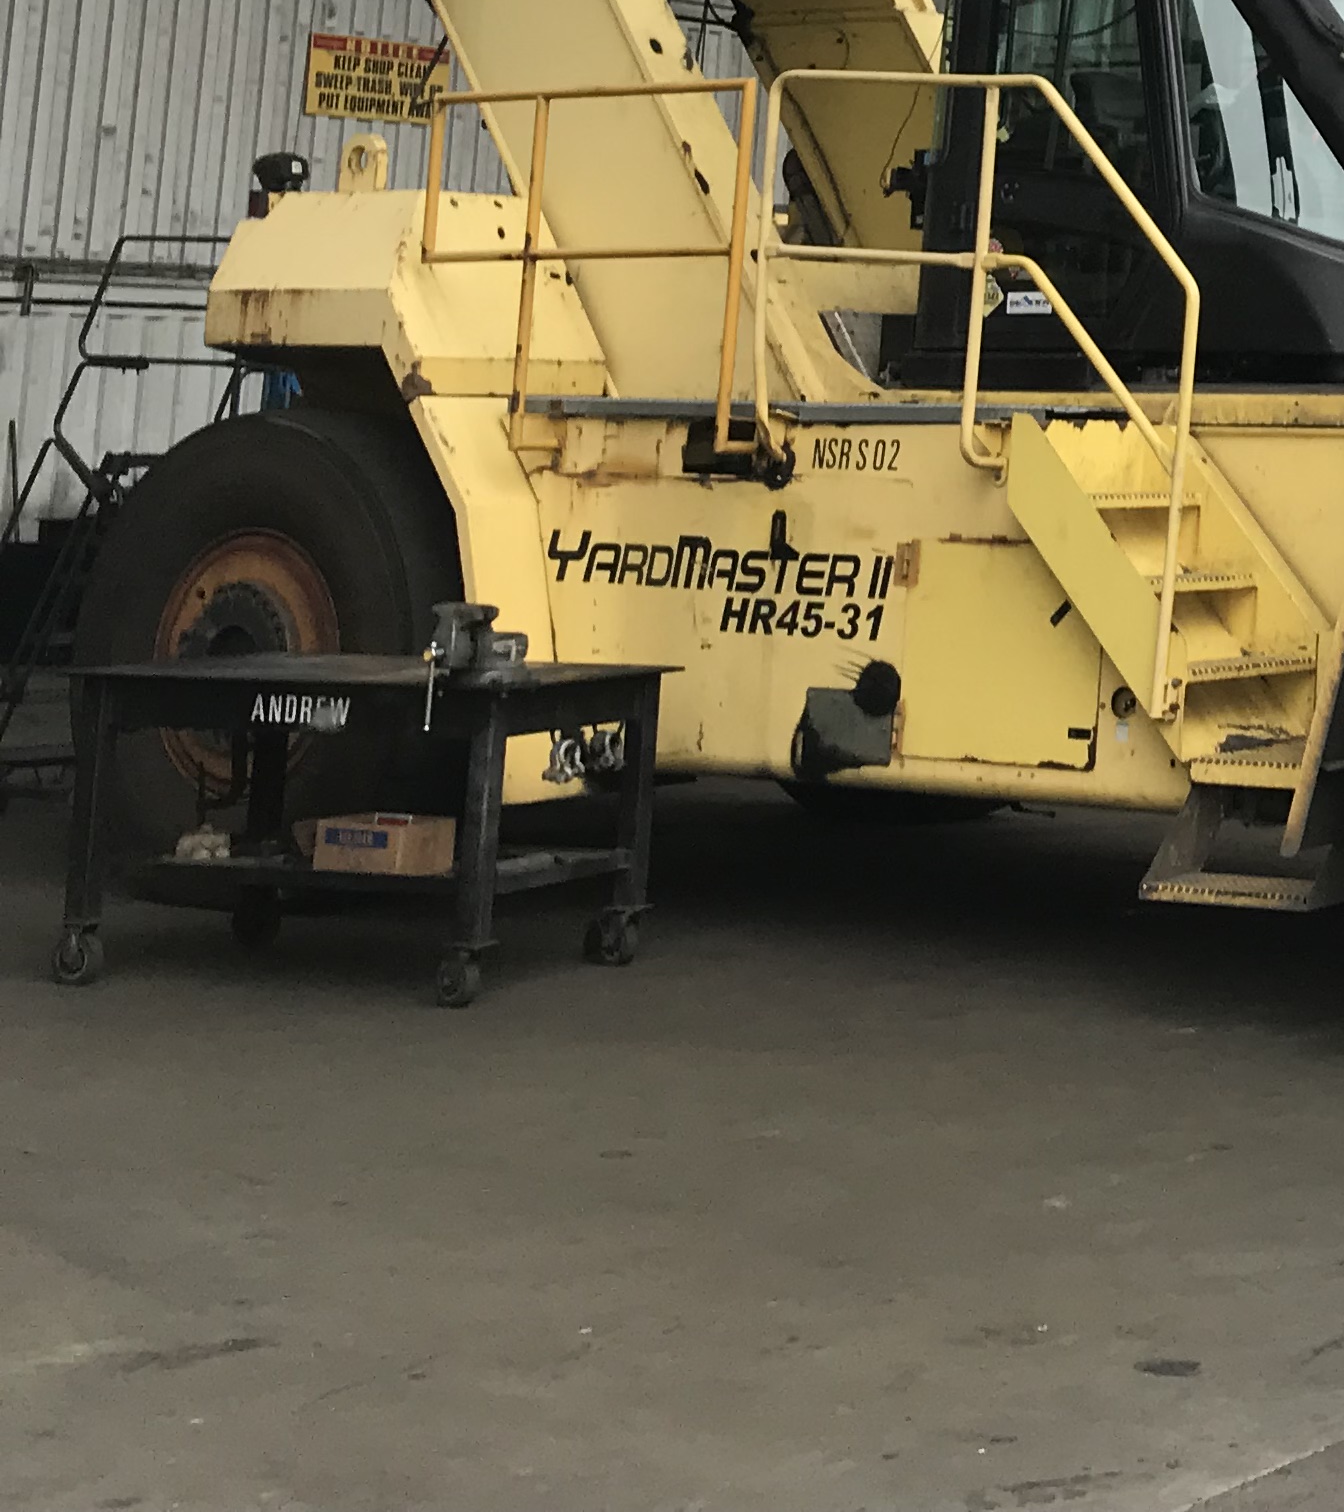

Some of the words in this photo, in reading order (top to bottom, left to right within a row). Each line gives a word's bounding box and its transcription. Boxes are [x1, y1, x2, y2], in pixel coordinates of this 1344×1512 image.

[333, 55, 361, 72] KEEP
[364, 57, 394, 76] SHOP
[318, 92, 341, 110] PUT
[344, 94, 405, 117] EQUIPMENT
[408, 98, 433, 120] AWA
[868, 555, 895, 600] II
[719, 596, 885, 642] HR45-31
